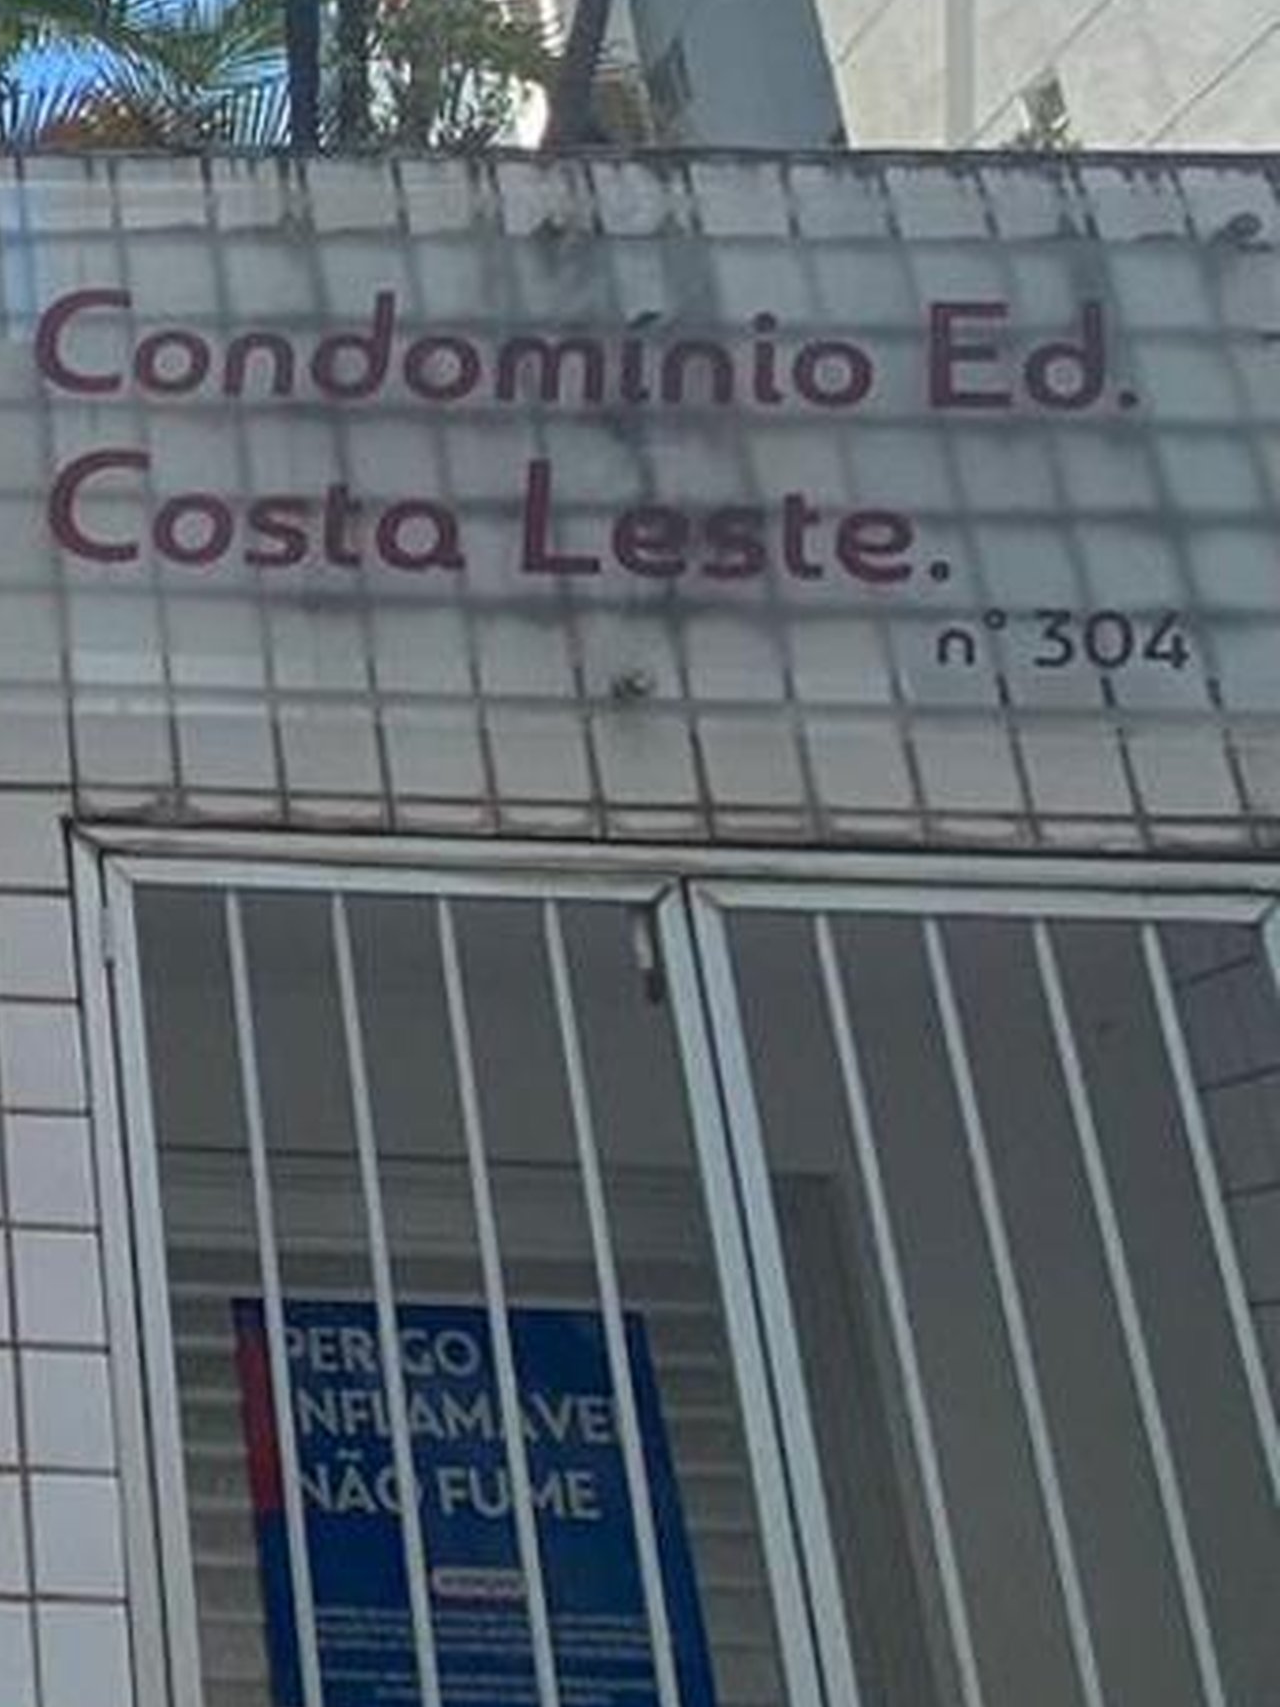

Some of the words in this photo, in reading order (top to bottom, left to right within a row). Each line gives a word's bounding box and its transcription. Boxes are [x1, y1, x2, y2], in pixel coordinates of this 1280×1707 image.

[34, 288, 874, 410] Condomínio
[929, 300, 1139, 411] Ed.
[48, 447, 466, 570] Costa
[520, 457, 952, 586] Leste.
[1033, 608, 1191, 670] 304
[283, 1326, 482, 1377] PERGO
[294, 1389, 622, 1444] NFLAMVE
